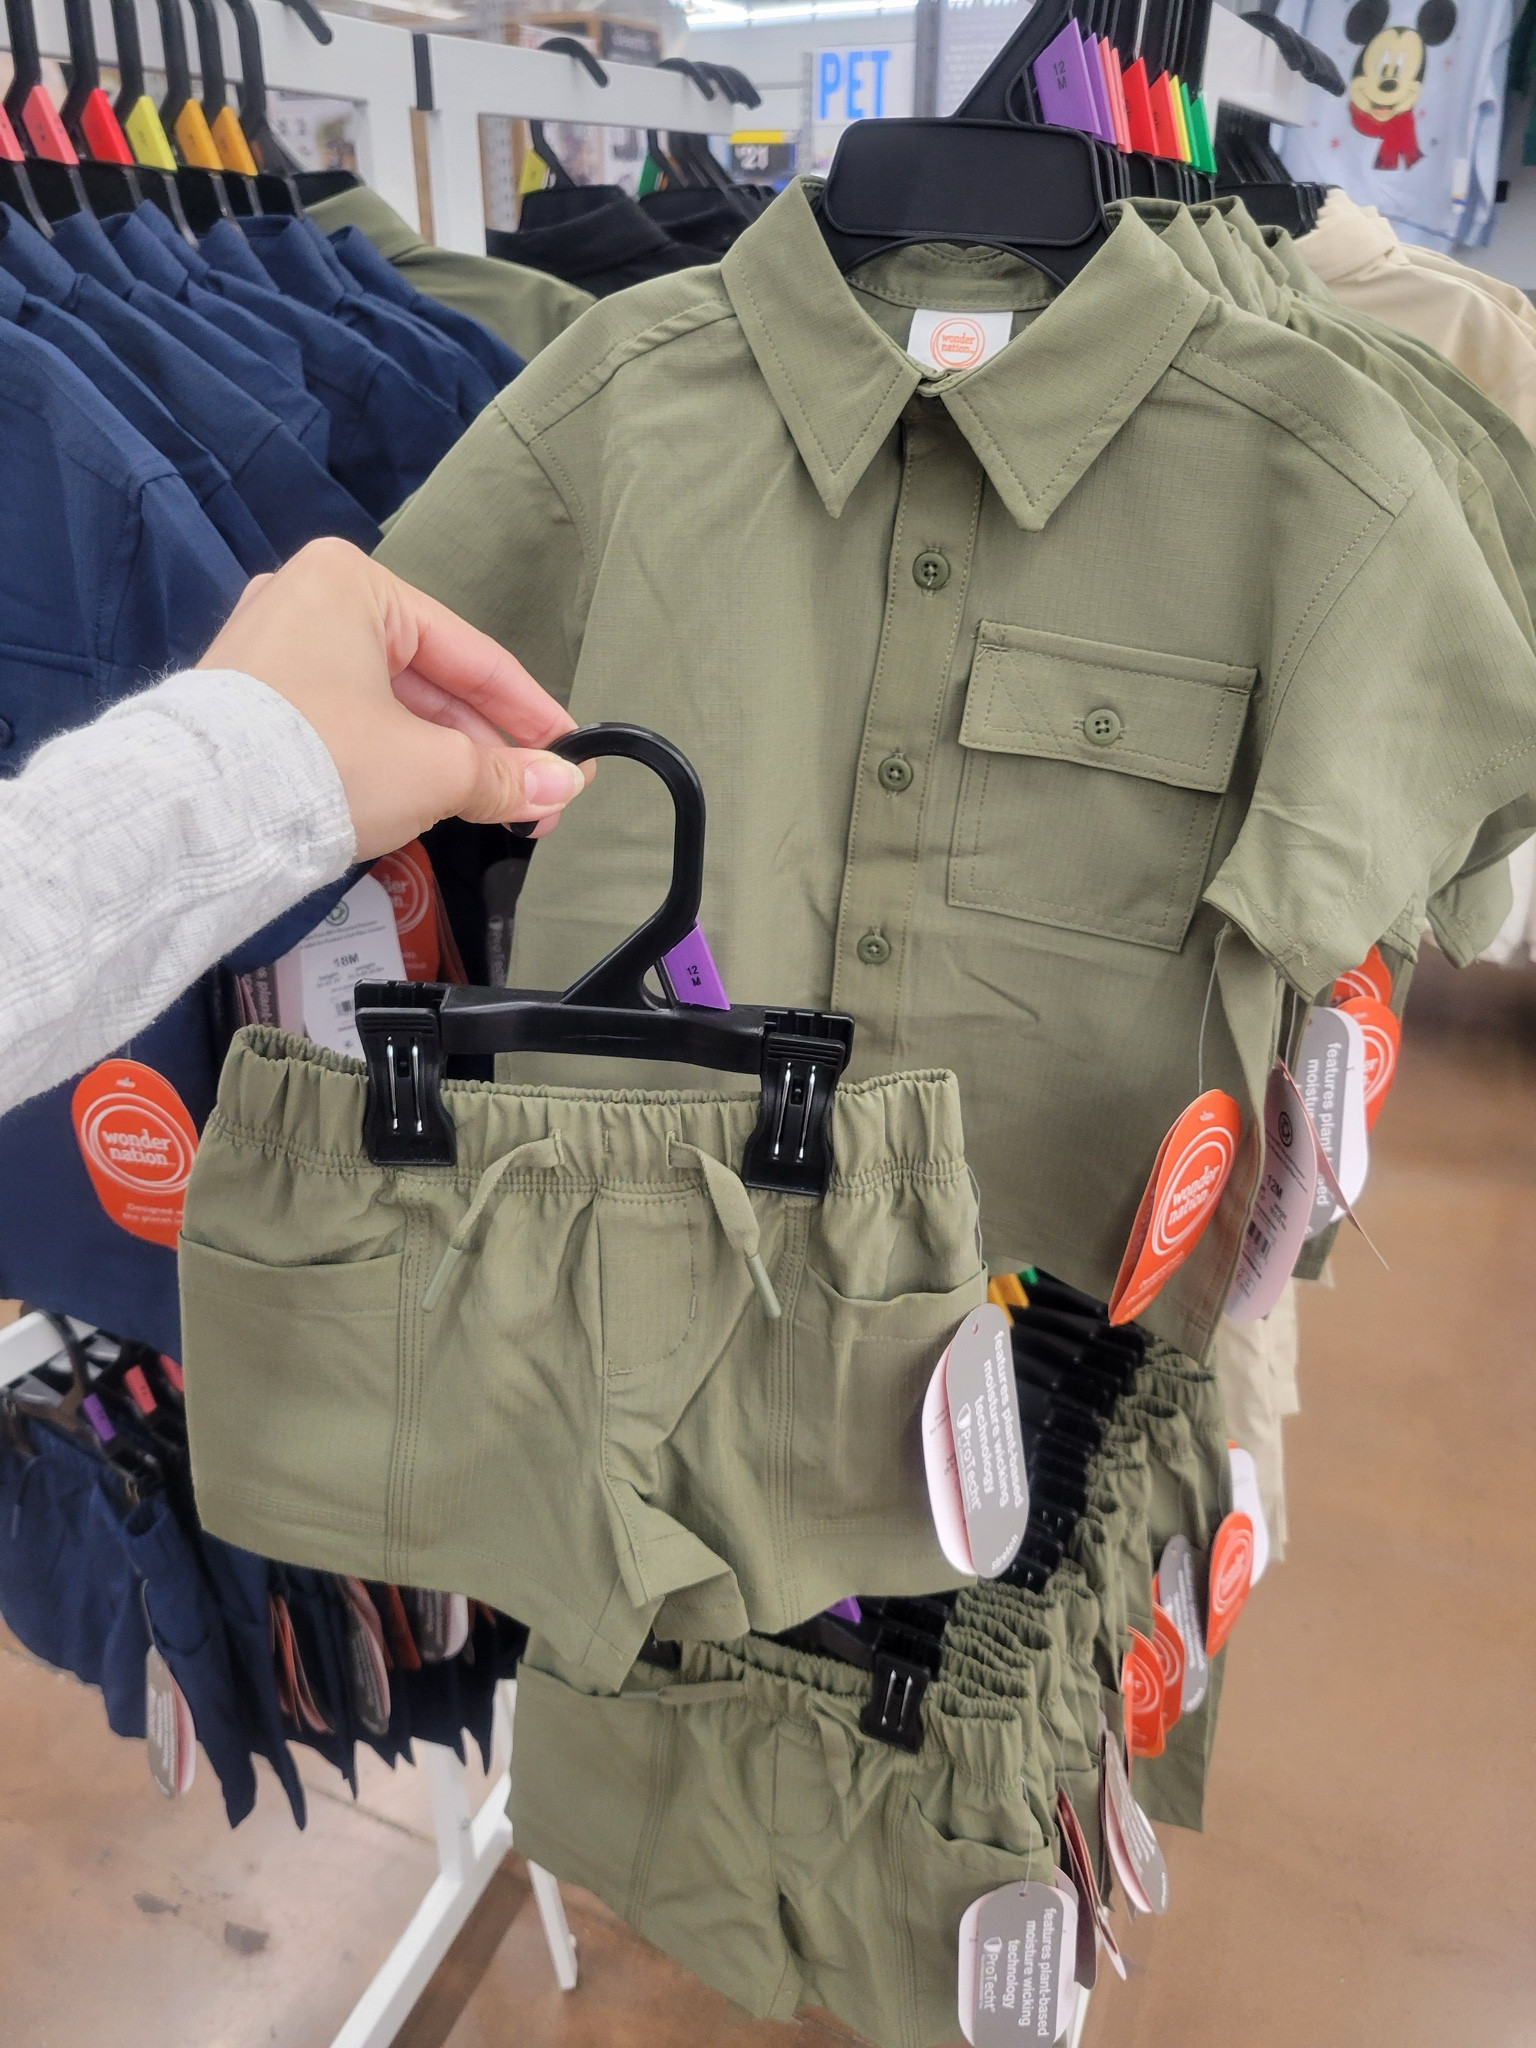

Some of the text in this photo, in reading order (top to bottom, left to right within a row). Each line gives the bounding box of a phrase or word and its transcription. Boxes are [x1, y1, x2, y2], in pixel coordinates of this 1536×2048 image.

[819, 50, 891, 120] PET
[1053, 60, 1066, 75] 12
[1057, 77, 1067, 90] M
[941, 331, 976, 345] wonder
[941, 343, 970, 354] nation
[333, 953, 359, 968] 18M
[687, 965, 699, 975] 12
[692, 977, 701, 986] M
[1304, 1058, 1319, 1121] moistur
[1322, 1042, 1342, 1111] features
[102, 1129, 171, 1150] wonder
[109, 1148, 168, 1165] nation
[1172, 1164, 1221, 1207] wonder
[1267, 1174, 1284, 1201] 12M
[1166, 1188, 1210, 1227] nation
[983, 1358, 1010, 1508] moisture wicking
[994, 1330, 1025, 1508] features plant-based
[974, 1394, 995, 1495] technology
[990, 1533, 1019, 1571] stretch
[1002, 1939, 1021, 2009] technology
[1018, 1919, 1037, 2027] moisture wicking
[1037, 1907, 1058, 2037] features plant-based
